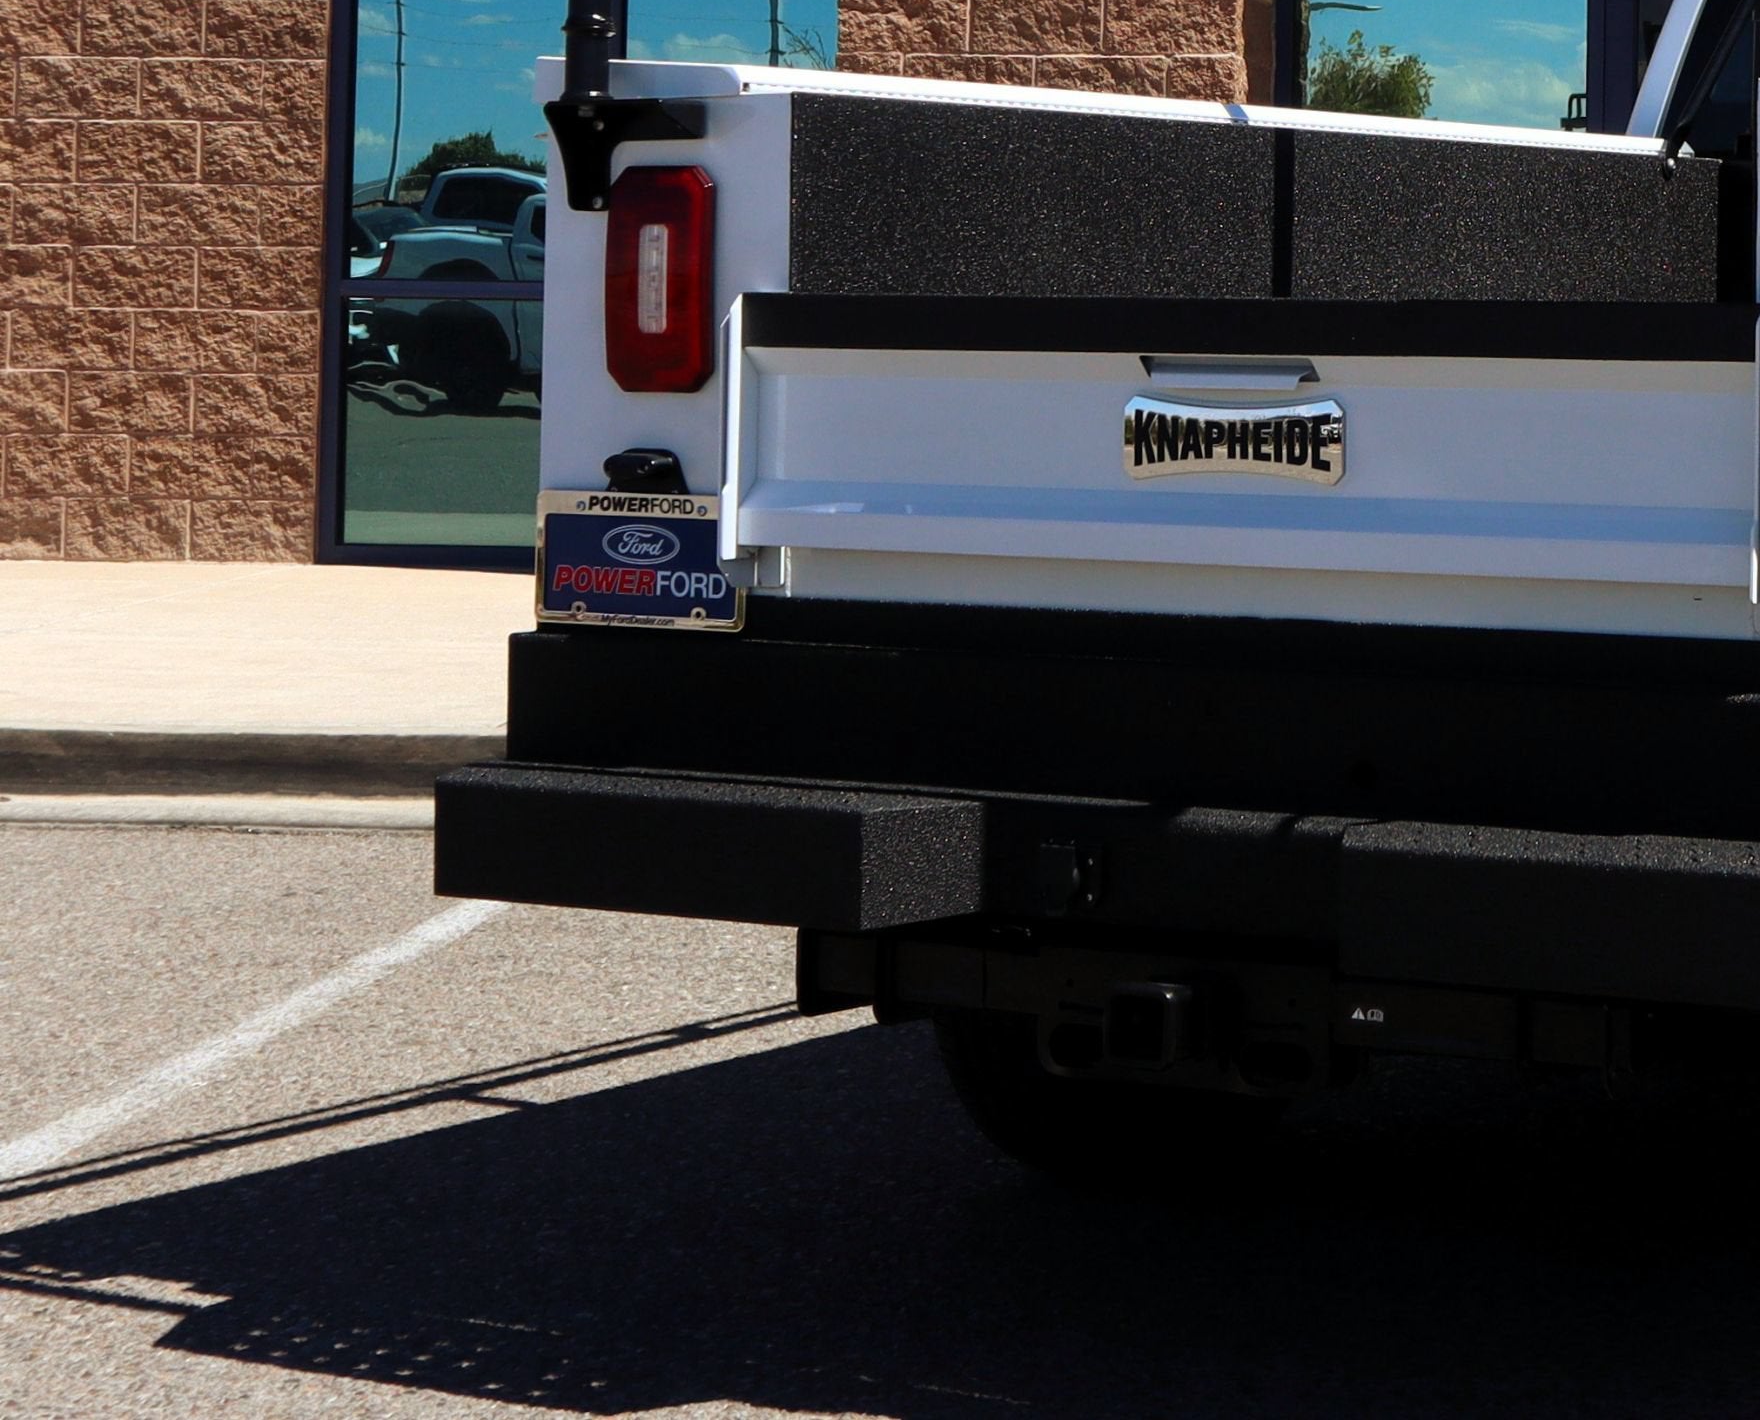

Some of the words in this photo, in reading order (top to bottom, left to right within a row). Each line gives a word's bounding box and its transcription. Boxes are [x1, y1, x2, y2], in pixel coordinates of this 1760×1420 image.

[1134, 409, 1332, 472] KNAPHEIDE
[587, 495, 695, 516] POWERFORD
[617, 531, 664, 557] Ford
[553, 565, 727, 599] POWERFORD
